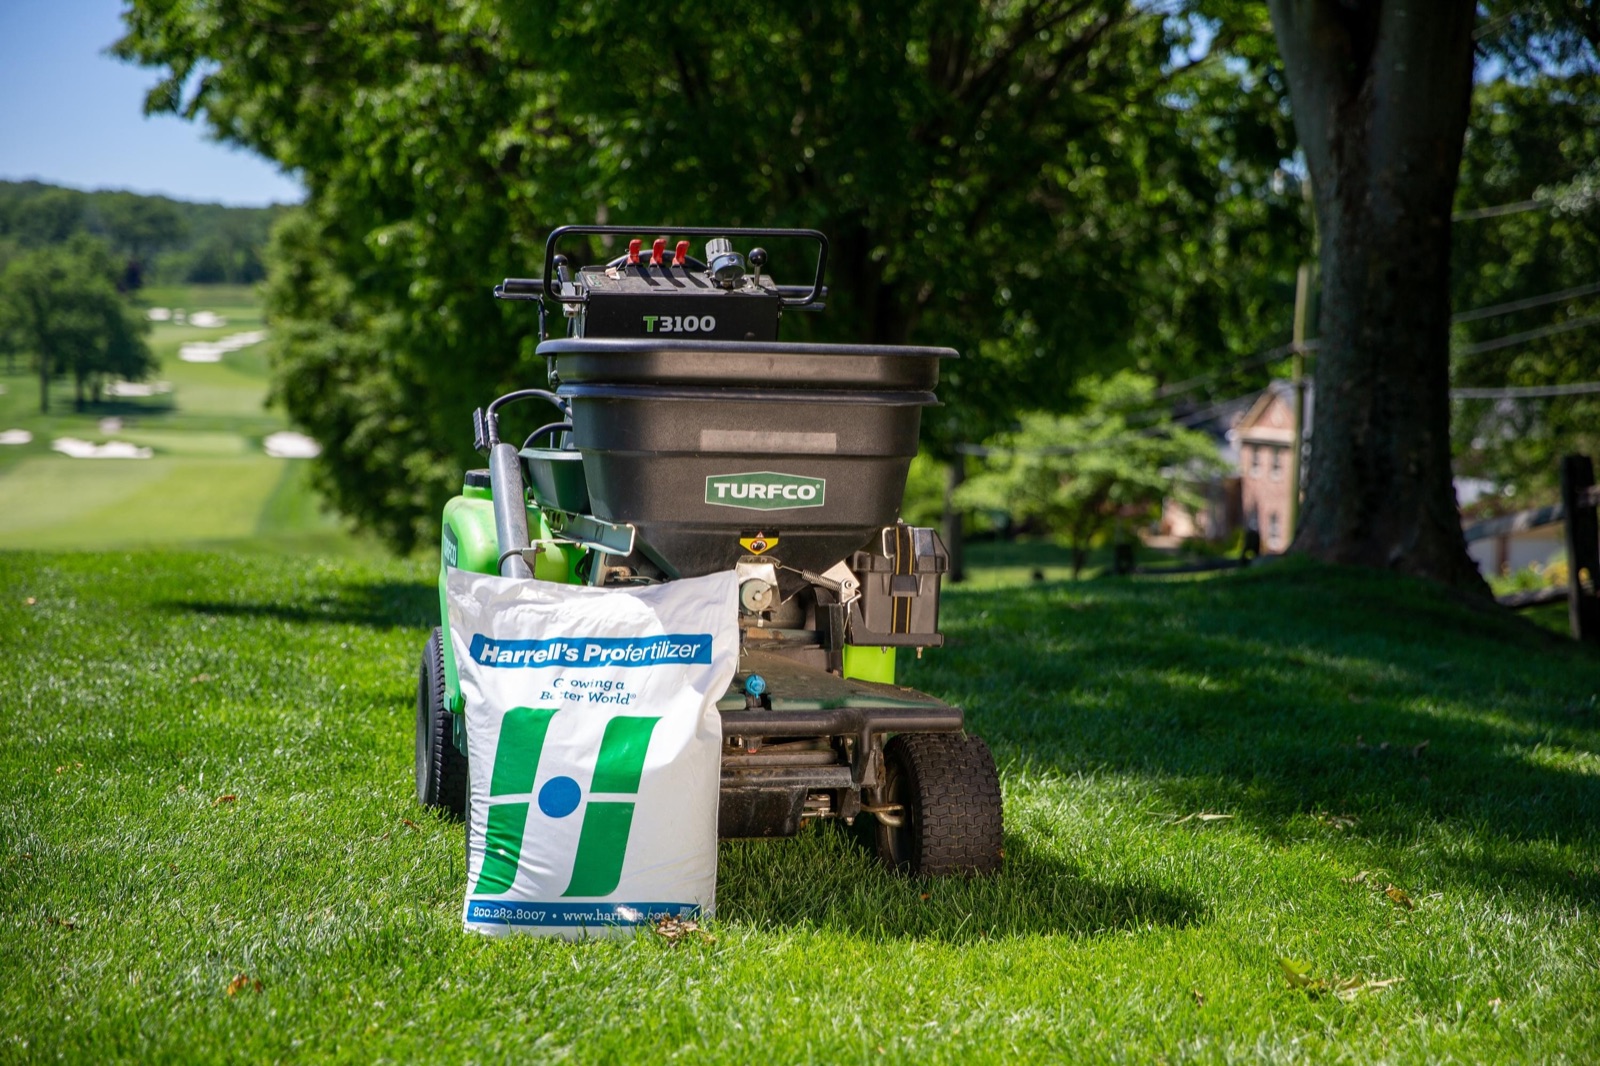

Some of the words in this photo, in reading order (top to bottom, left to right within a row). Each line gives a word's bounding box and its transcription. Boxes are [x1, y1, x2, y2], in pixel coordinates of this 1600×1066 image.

[642, 315, 716, 332] T3100
[479, 643, 579, 663] Harrell's
[583, 640, 701, 662] Profertilizer
[552, 678, 613, 692] Gowing
[615, 681, 625, 690] a
[539, 690, 584, 702] Beter
[473, 906, 546, 921] 800.282.8007
